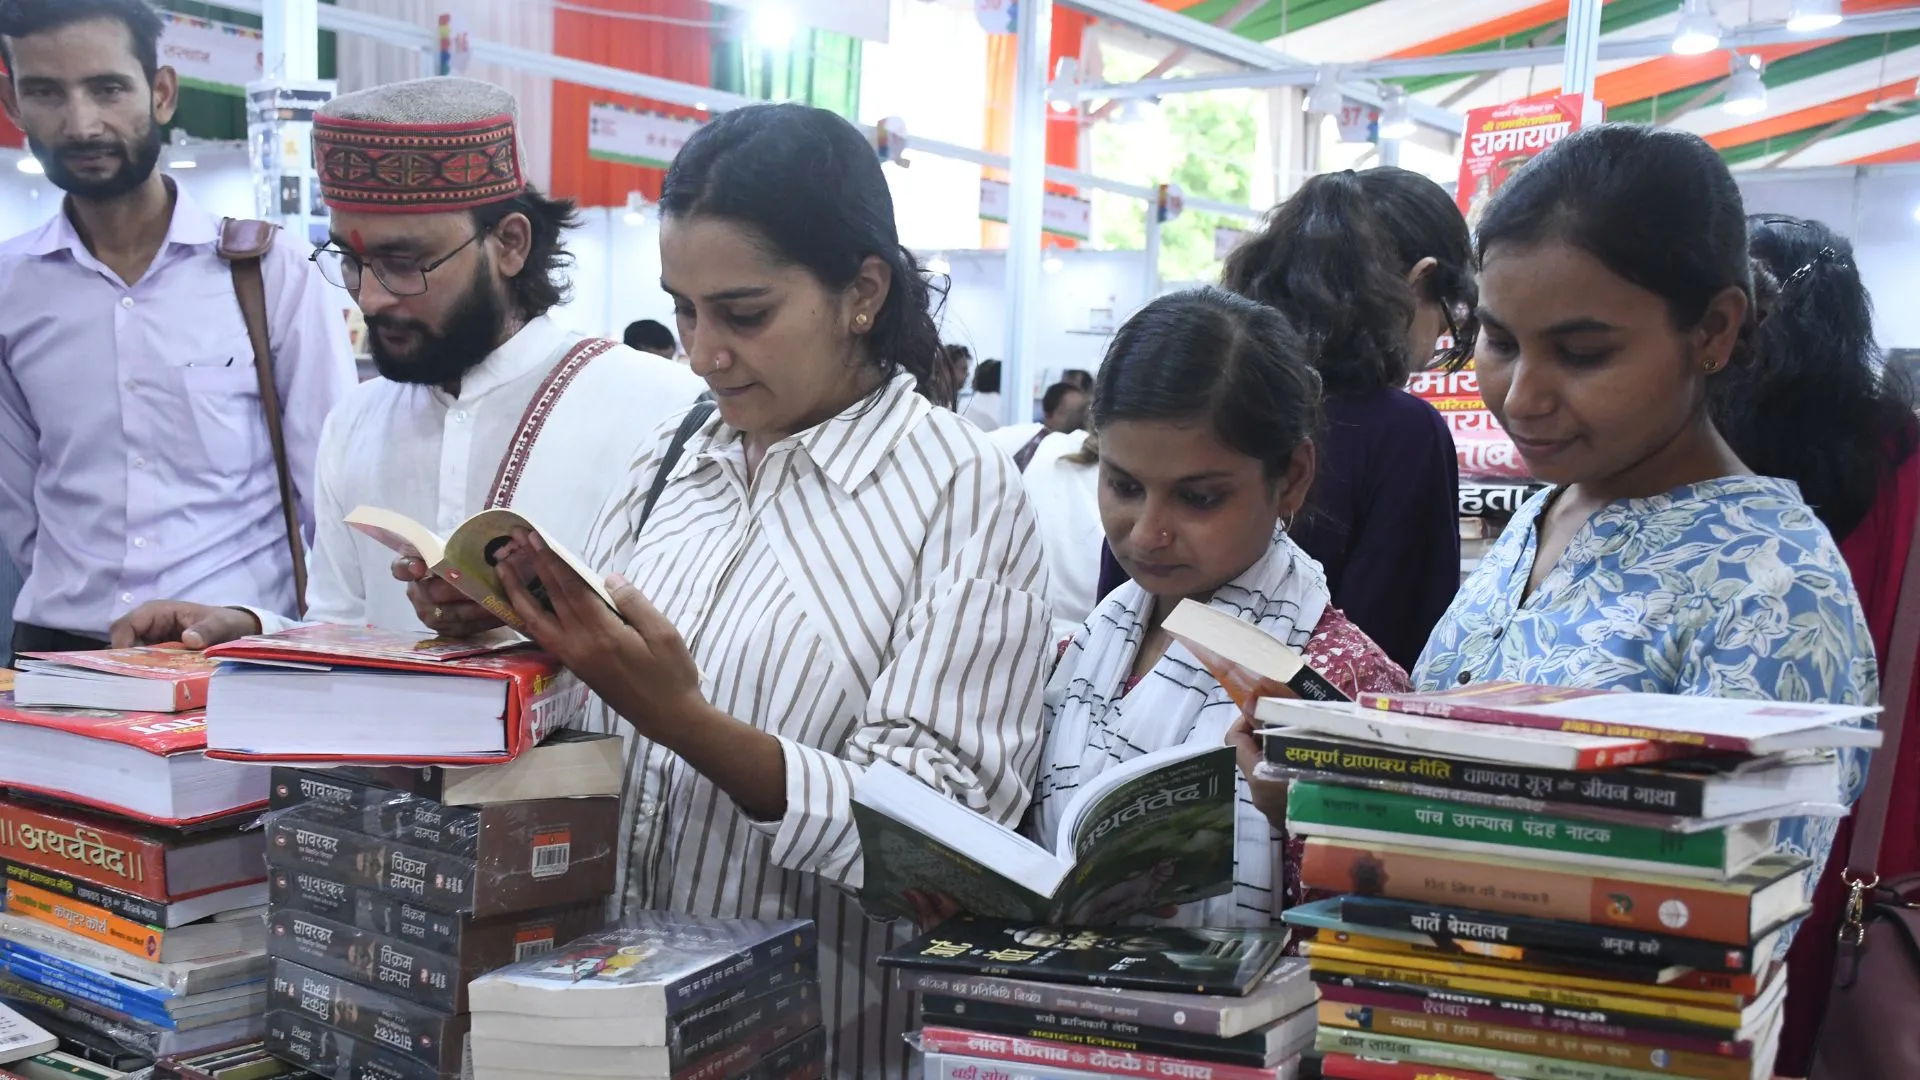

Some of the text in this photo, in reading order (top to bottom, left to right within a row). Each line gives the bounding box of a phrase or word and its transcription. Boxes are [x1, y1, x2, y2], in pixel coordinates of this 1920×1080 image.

[1341, 106, 1362, 127] 37
[1471, 121, 1572, 156] रामायण
[1285, 746, 1340, 769] सम्पूर्ण
[1342, 752, 1406, 774] चाणक्य
[1409, 758, 1452, 779] नीति
[1463, 767, 1521, 790] चाणक्य
[1525, 774, 1554, 797] सूत्र
[1580, 777, 1629, 802] जीवन
[1633, 786, 1678, 807] गाथा
[296, 828, 339, 852] सावरकर
[1452, 813, 1514, 834] उपन्यास
[1565, 824, 1612, 844] नाटक
[391, 851, 428, 877] विक्रम
[389, 872, 425, 895] सम्पत
[293, 919, 334, 944] सावरकर
[1410, 911, 1509, 941] बातें बेमतलब
[380, 944, 414, 971] विक्रम
[1601, 936, 1635, 954] अनुज
[379, 964, 411, 989] सम्पत
[967, 1036, 1007, 1055] लाल
[1011, 1037, 1069, 1062] किताब
[1160, 1060, 1213, 1080] उपाय
